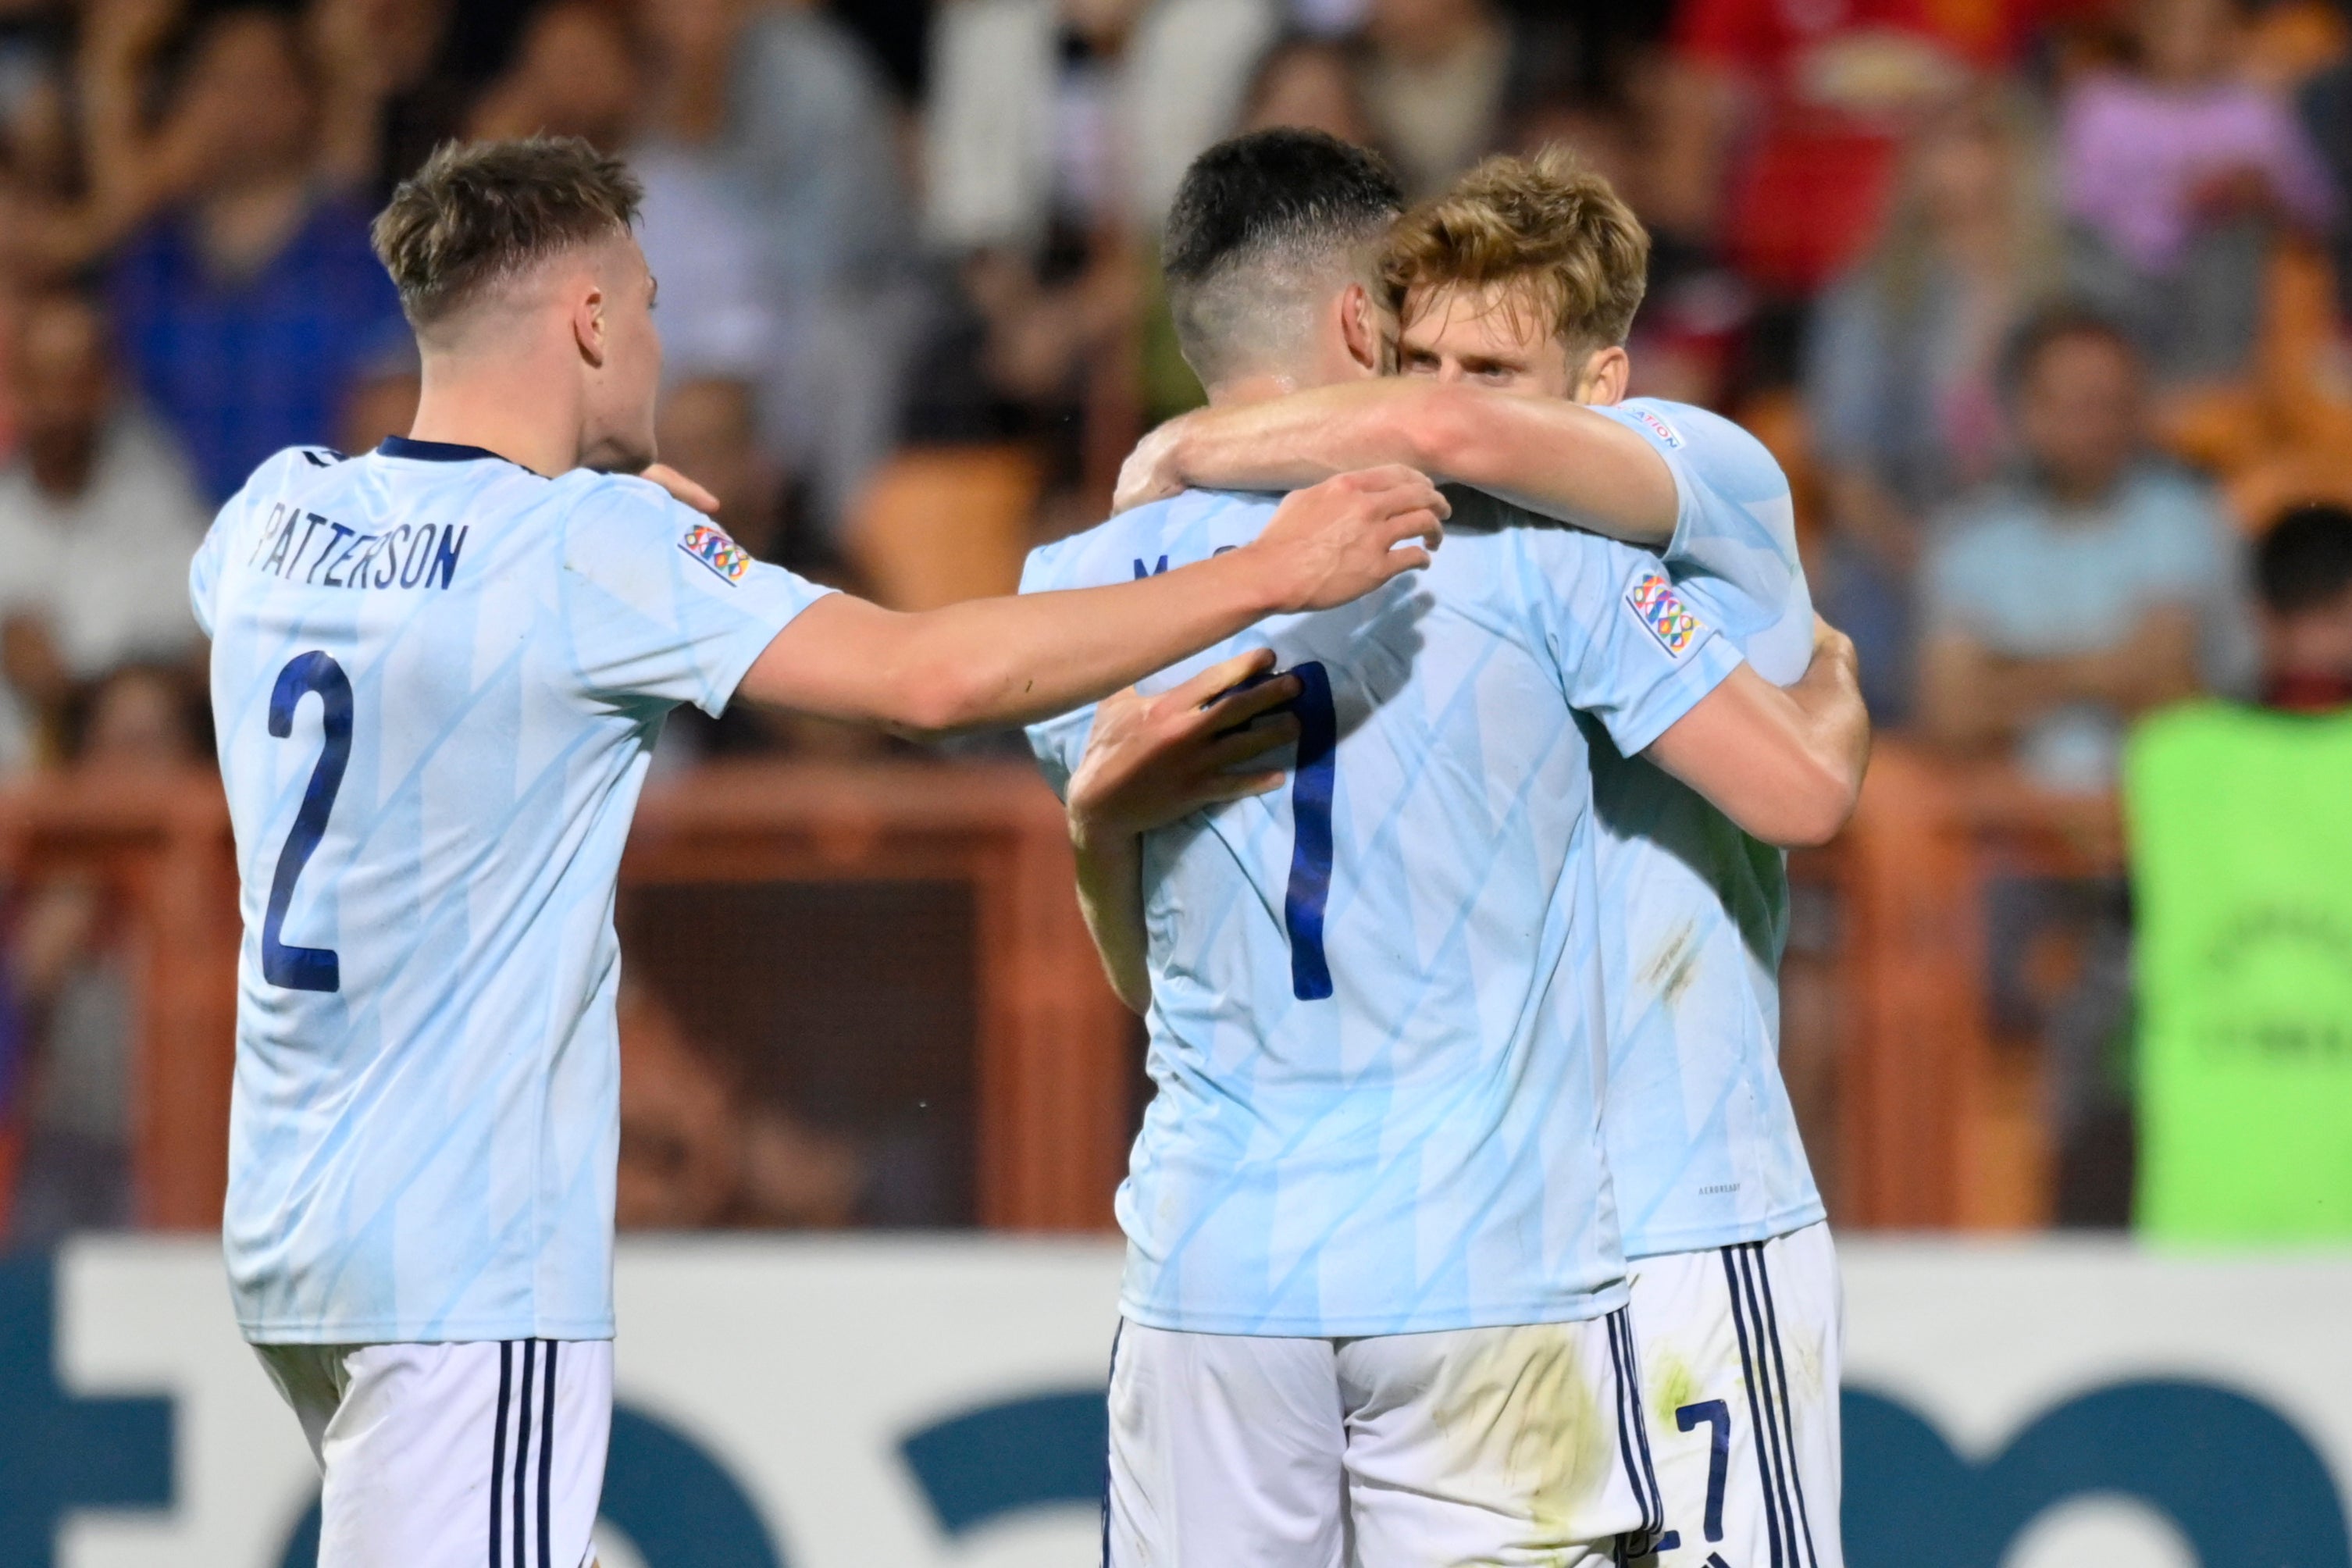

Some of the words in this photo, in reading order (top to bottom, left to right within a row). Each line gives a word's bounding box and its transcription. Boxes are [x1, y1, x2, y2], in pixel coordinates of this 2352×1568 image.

[248, 502, 469, 590] PATTERSON
[262, 650, 354, 992] 2
[1203, 661, 1337, 1000] 7
[1652, 1399, 1731, 1552] 7
